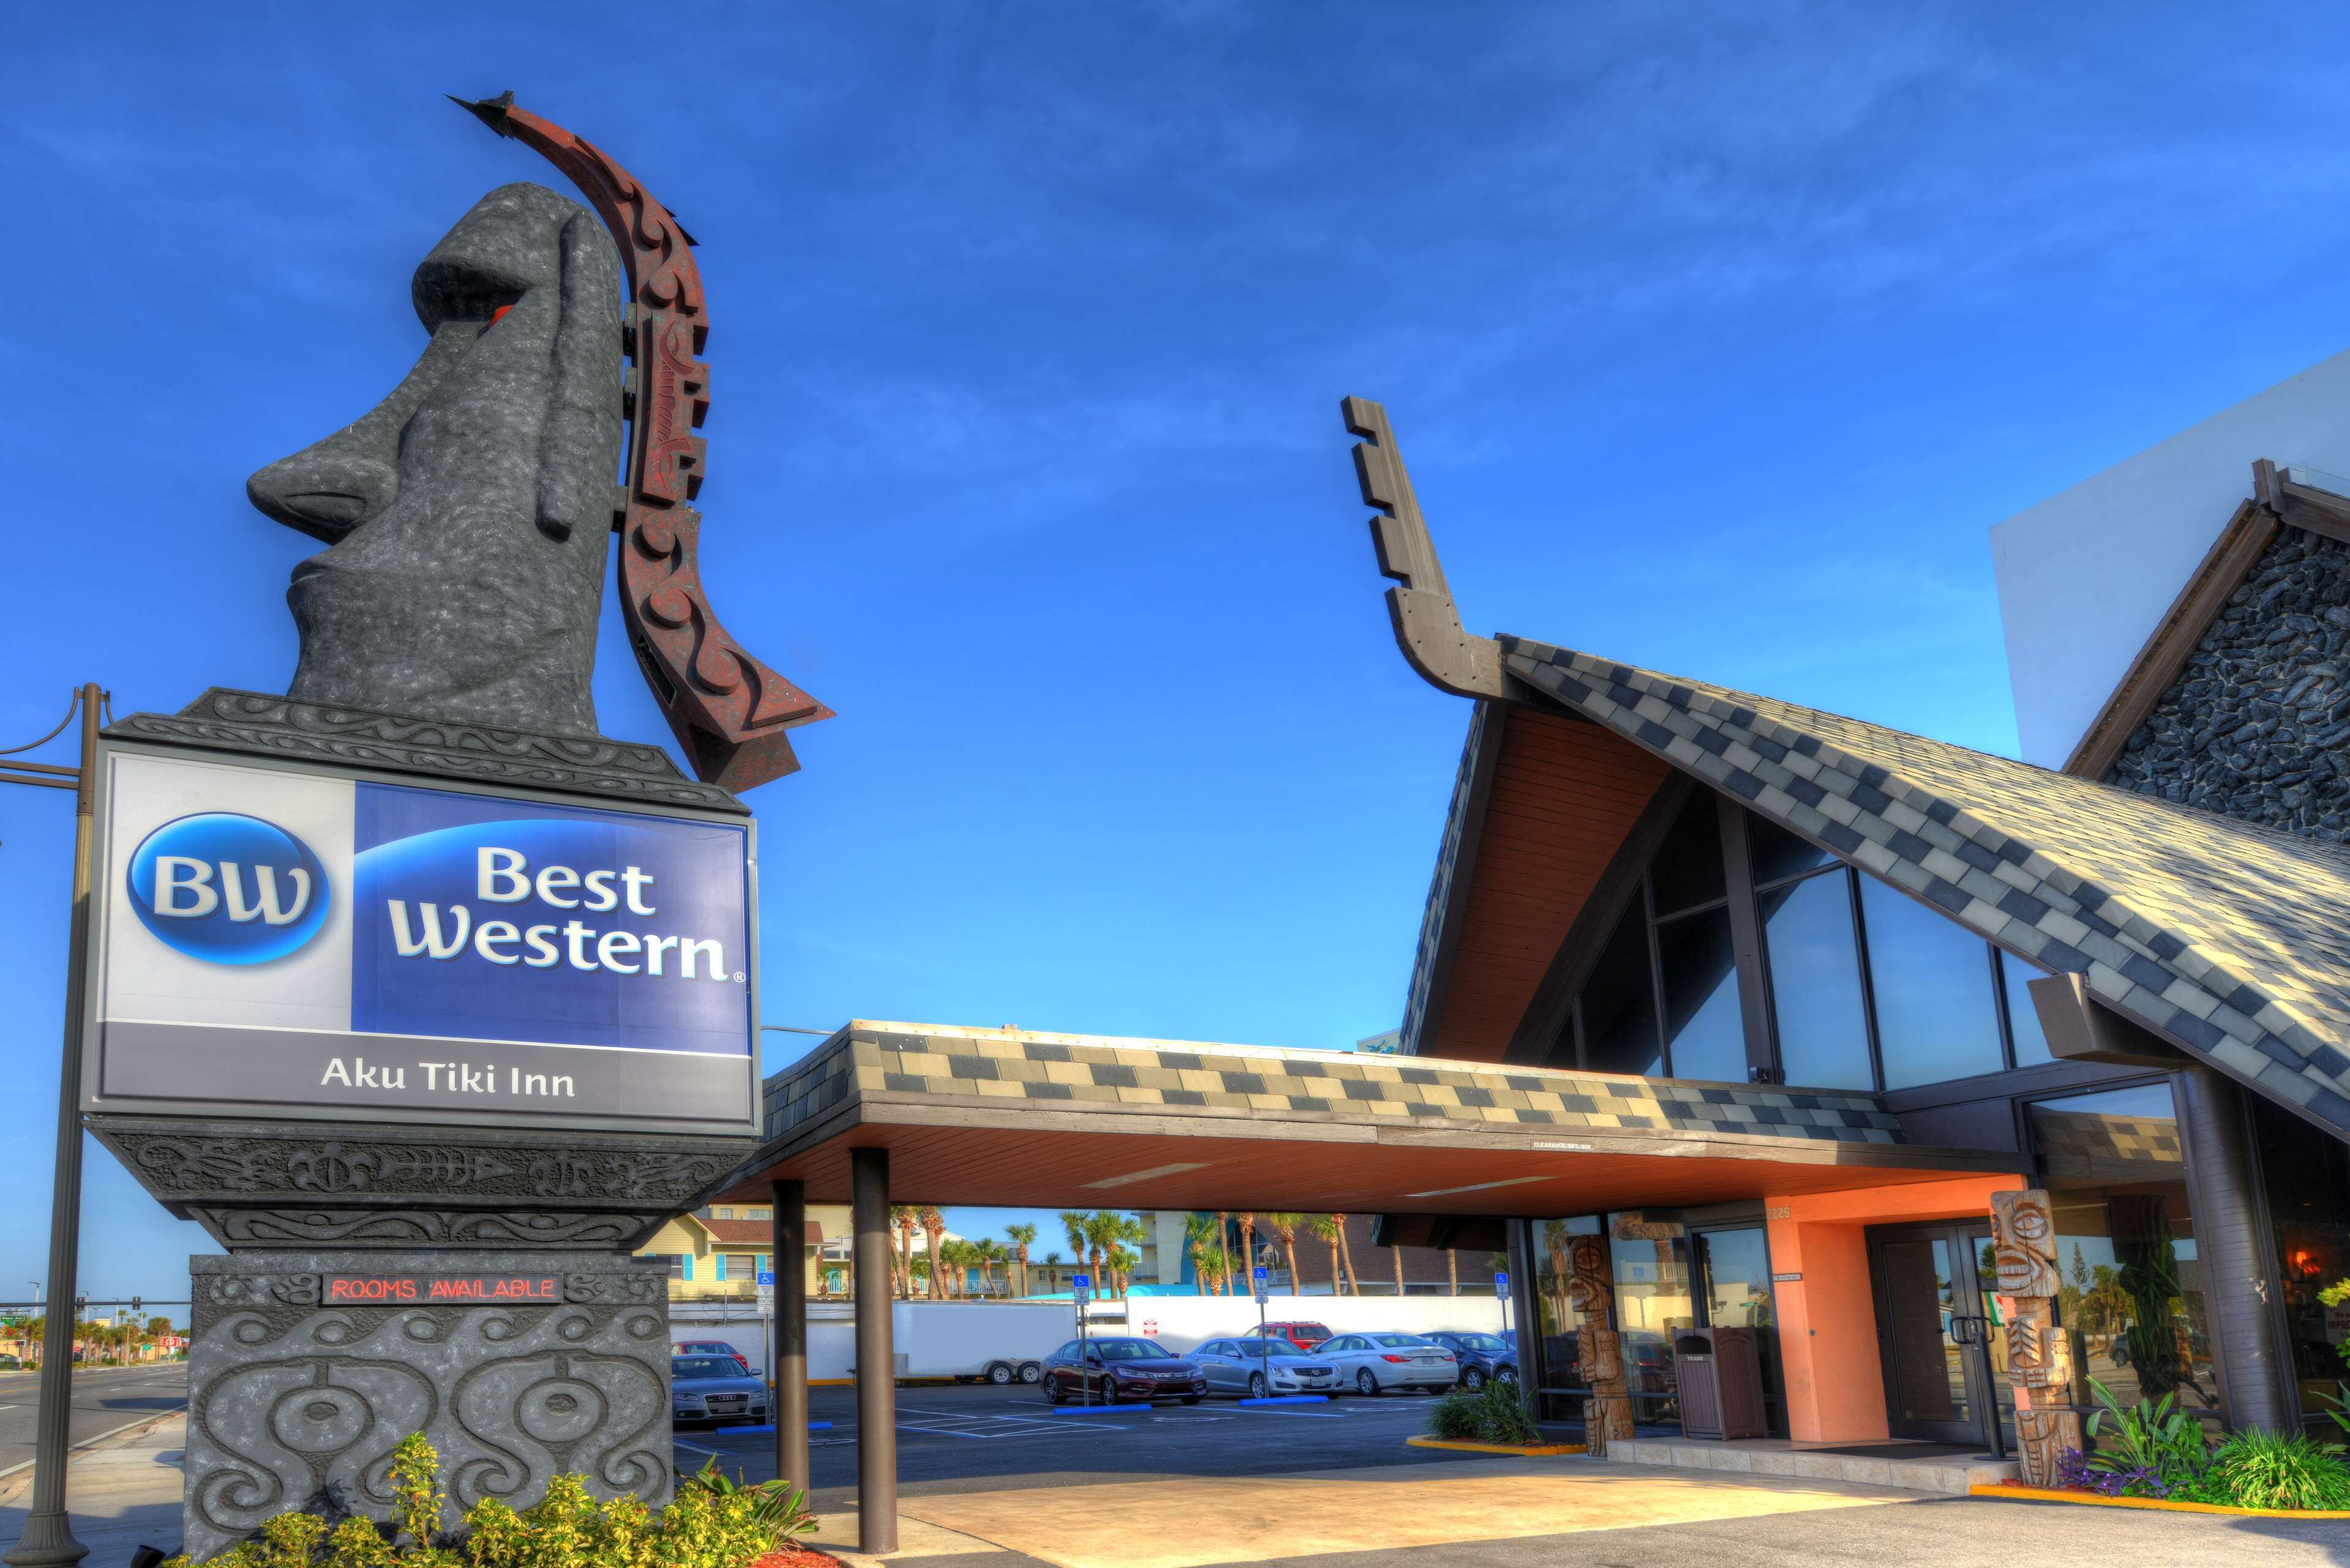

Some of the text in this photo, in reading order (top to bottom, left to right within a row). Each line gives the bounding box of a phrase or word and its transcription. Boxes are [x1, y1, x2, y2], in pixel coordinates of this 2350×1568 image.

[154, 856, 312, 925] BW
[477, 846, 656, 916] Best
[387, 898, 728, 982] Western
[320, 1058, 575, 1097] Aku Tiki Inn
[1766, 1206, 1791, 1220] 2225
[332, 1279, 555, 1299] ROOMS AVAILABLE
